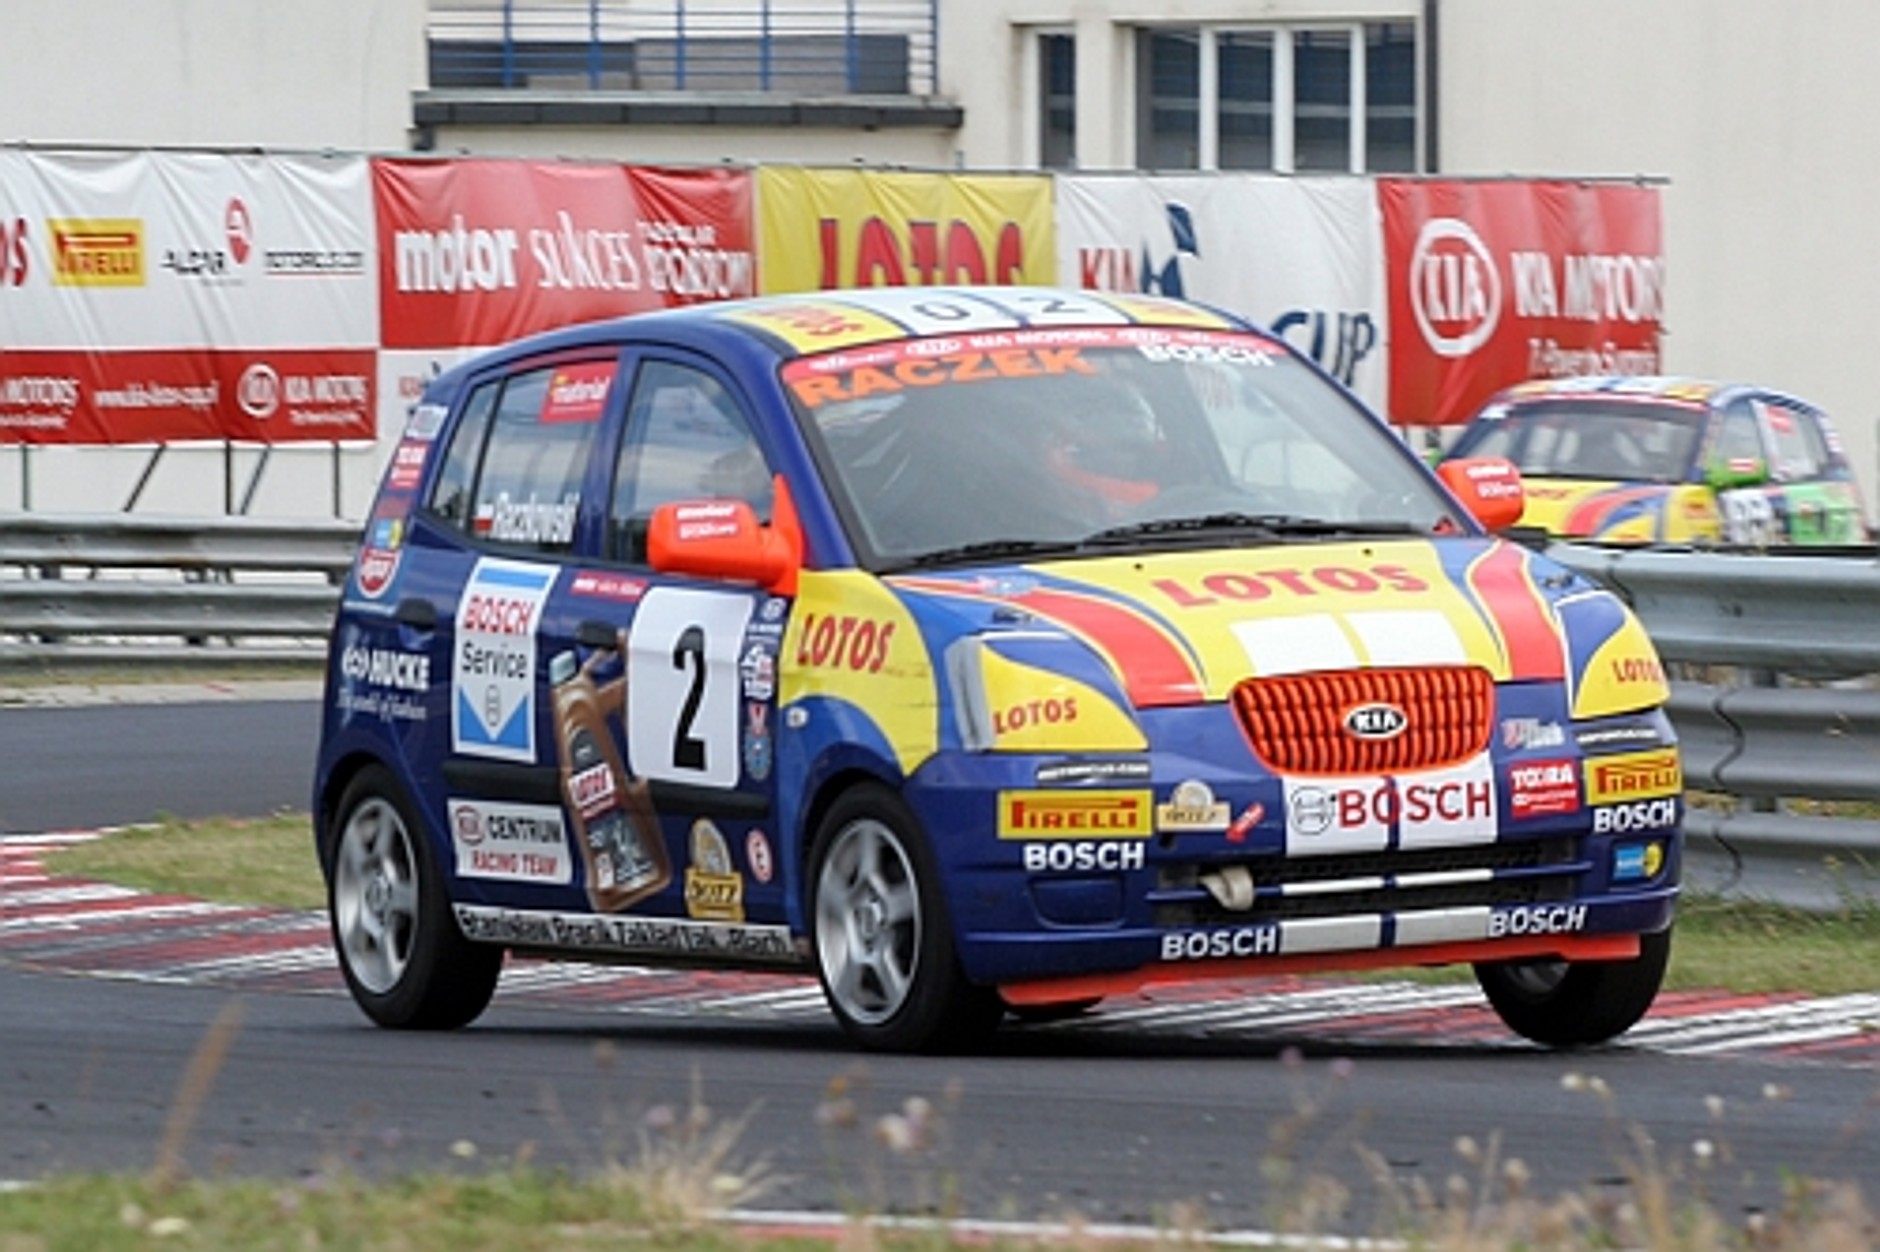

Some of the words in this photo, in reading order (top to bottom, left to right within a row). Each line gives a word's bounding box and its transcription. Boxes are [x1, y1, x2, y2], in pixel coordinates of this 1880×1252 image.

[394, 213, 518, 292] motor
[1423, 253, 1488, 321] KIA
[1137, 344, 1275, 367] BOSCH
[790, 348, 1097, 408] RACZEK
[1152, 567, 1429, 607] LOTOS
[462, 594, 534, 636] BOSCH
[461, 640, 528, 680] Service
[797, 612, 896, 674] LOTOS
[672, 624, 706, 770] 2
[993, 698, 1077, 734] LOTOS
[1351, 708, 1398, 730] KIA
[1595, 758, 1677, 794] PIRELLI
[1011, 799, 1138, 828] PIRELLI
[1338, 781, 1492, 827] BOSCH
[1594, 798, 1675, 833] BOSCH
[486, 815, 563, 843] CENTRUM
[472, 852, 520, 873] RACING
[522, 856, 558, 876] TEAM
[1023, 842, 1144, 870] BOSCH
[1488, 905, 1587, 937] BOSCH
[1161, 926, 1277, 960] BOSCH
